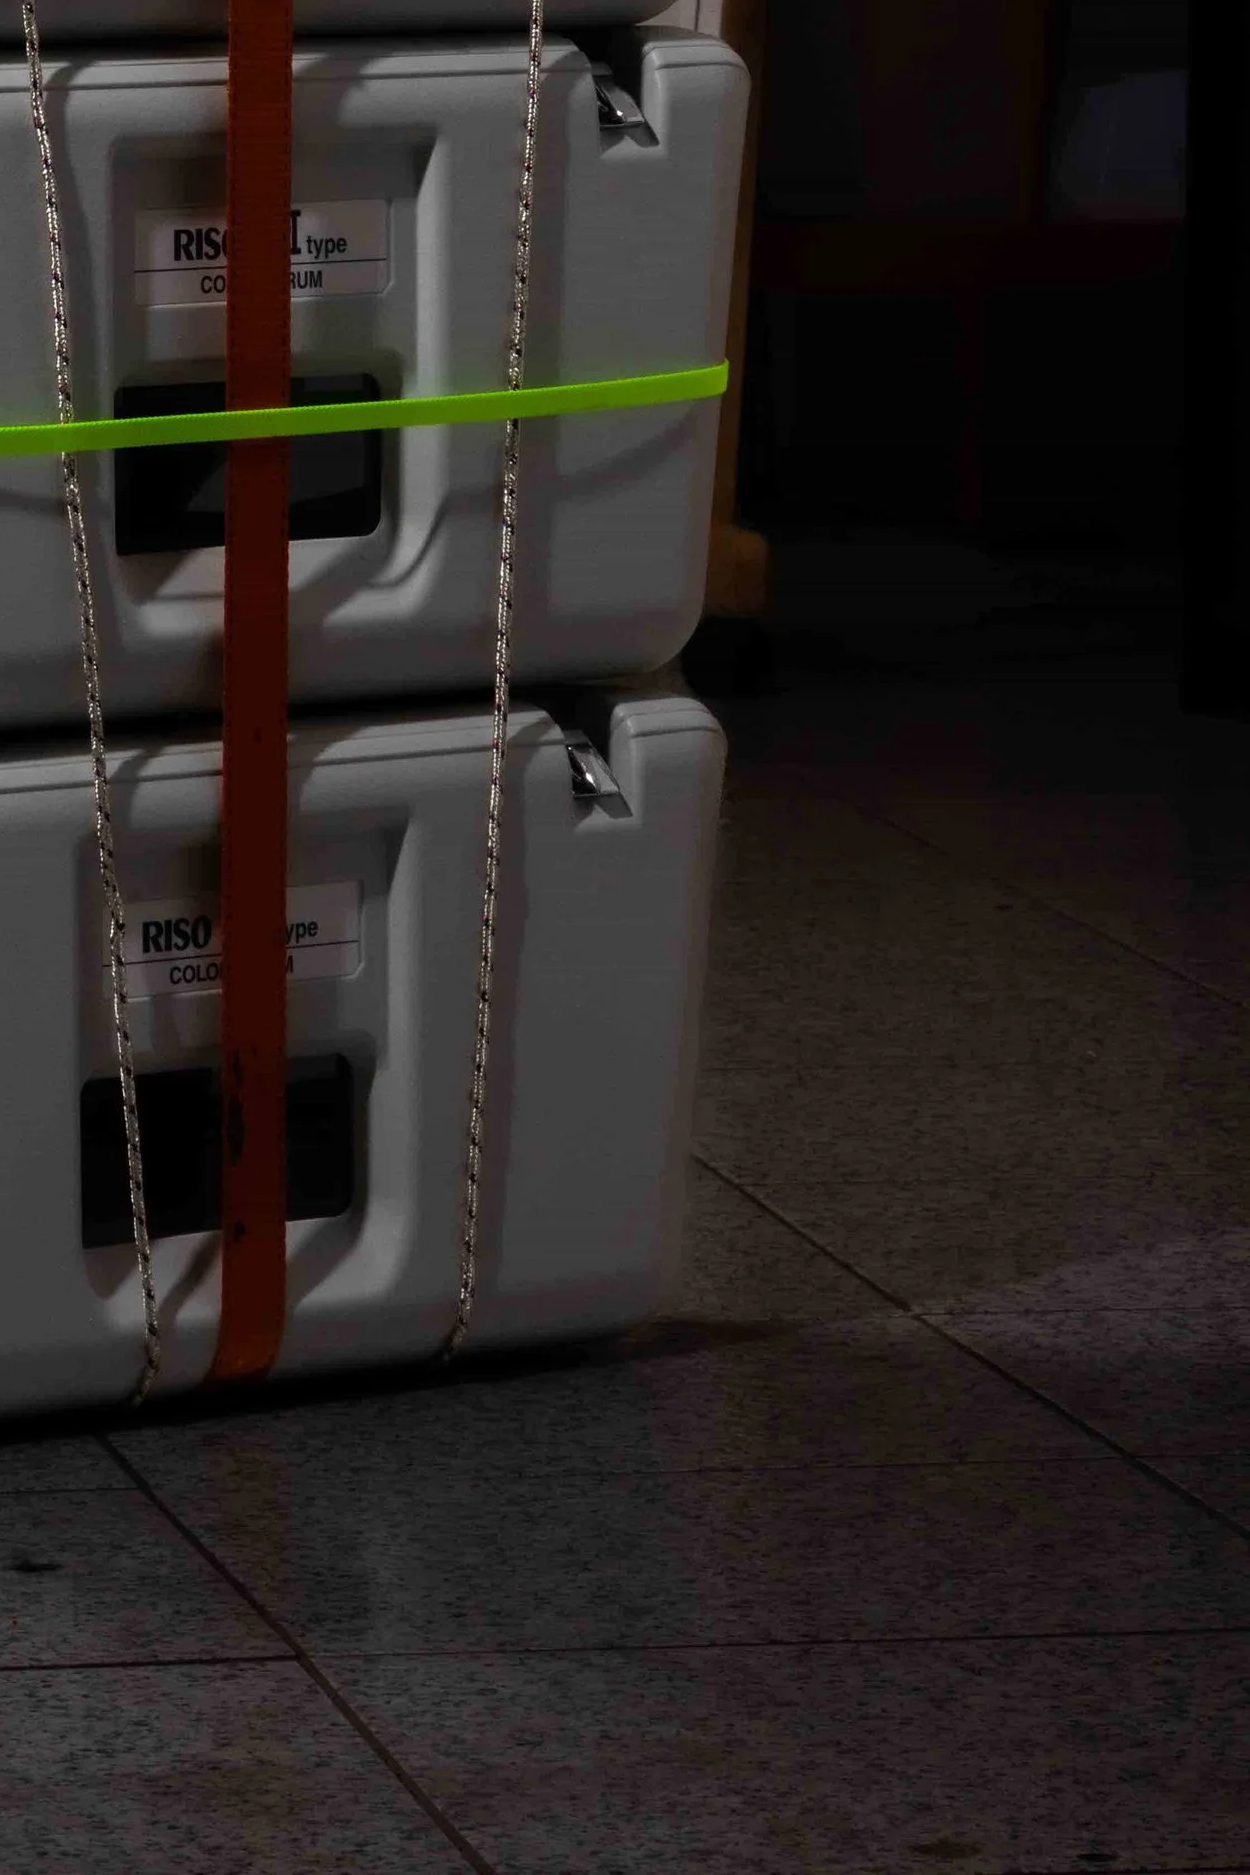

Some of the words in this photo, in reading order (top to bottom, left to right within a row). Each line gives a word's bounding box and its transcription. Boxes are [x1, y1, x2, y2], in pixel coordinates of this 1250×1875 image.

[306, 236, 347, 259] type
[142, 915, 212, 953] RISO
[286, 921, 319, 945] ype
[170, 962, 220, 985] COLO
